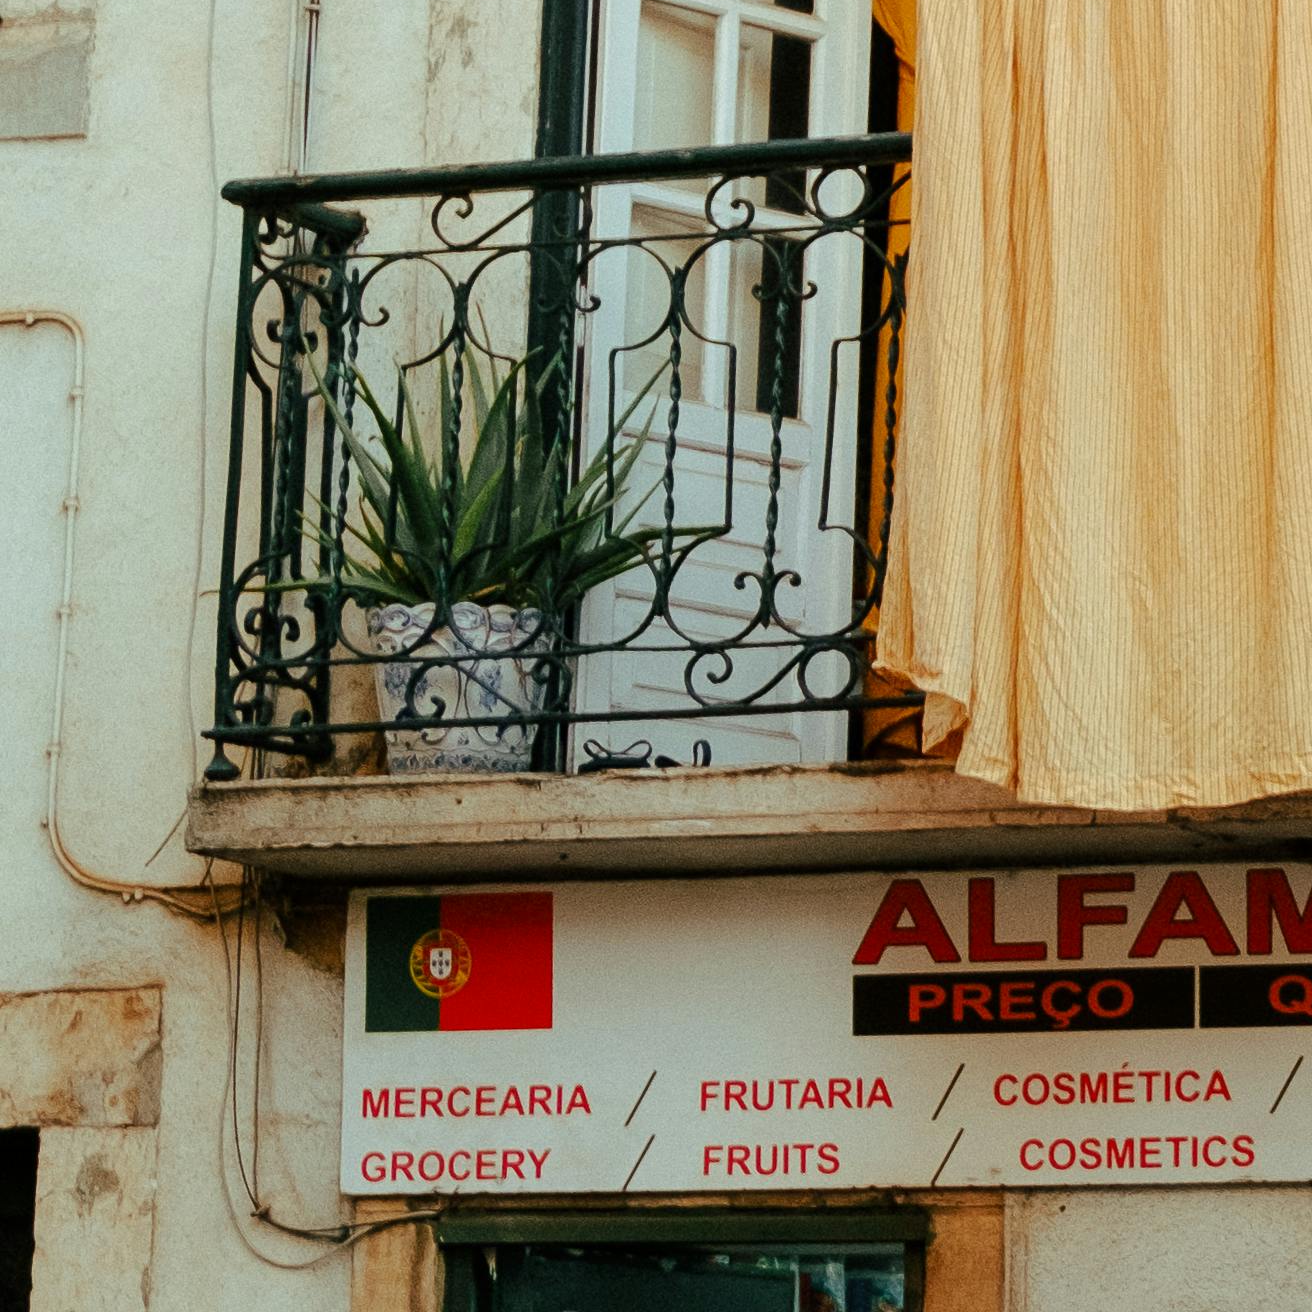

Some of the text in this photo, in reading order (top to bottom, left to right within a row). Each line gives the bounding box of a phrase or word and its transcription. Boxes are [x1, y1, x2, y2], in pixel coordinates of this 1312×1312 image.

[908, 980, 1134, 1030] PREÇO
[361, 1084, 592, 1119] MERCEARIA
[699, 1076, 893, 1112] FRUTARIA
[993, 1062, 1232, 1106] COSMÉTICA
[361, 1148, 551, 1184] GROCERY
[702, 1142, 840, 1177] FRUITS
[1019, 1134, 1256, 1172] COSMETICS
